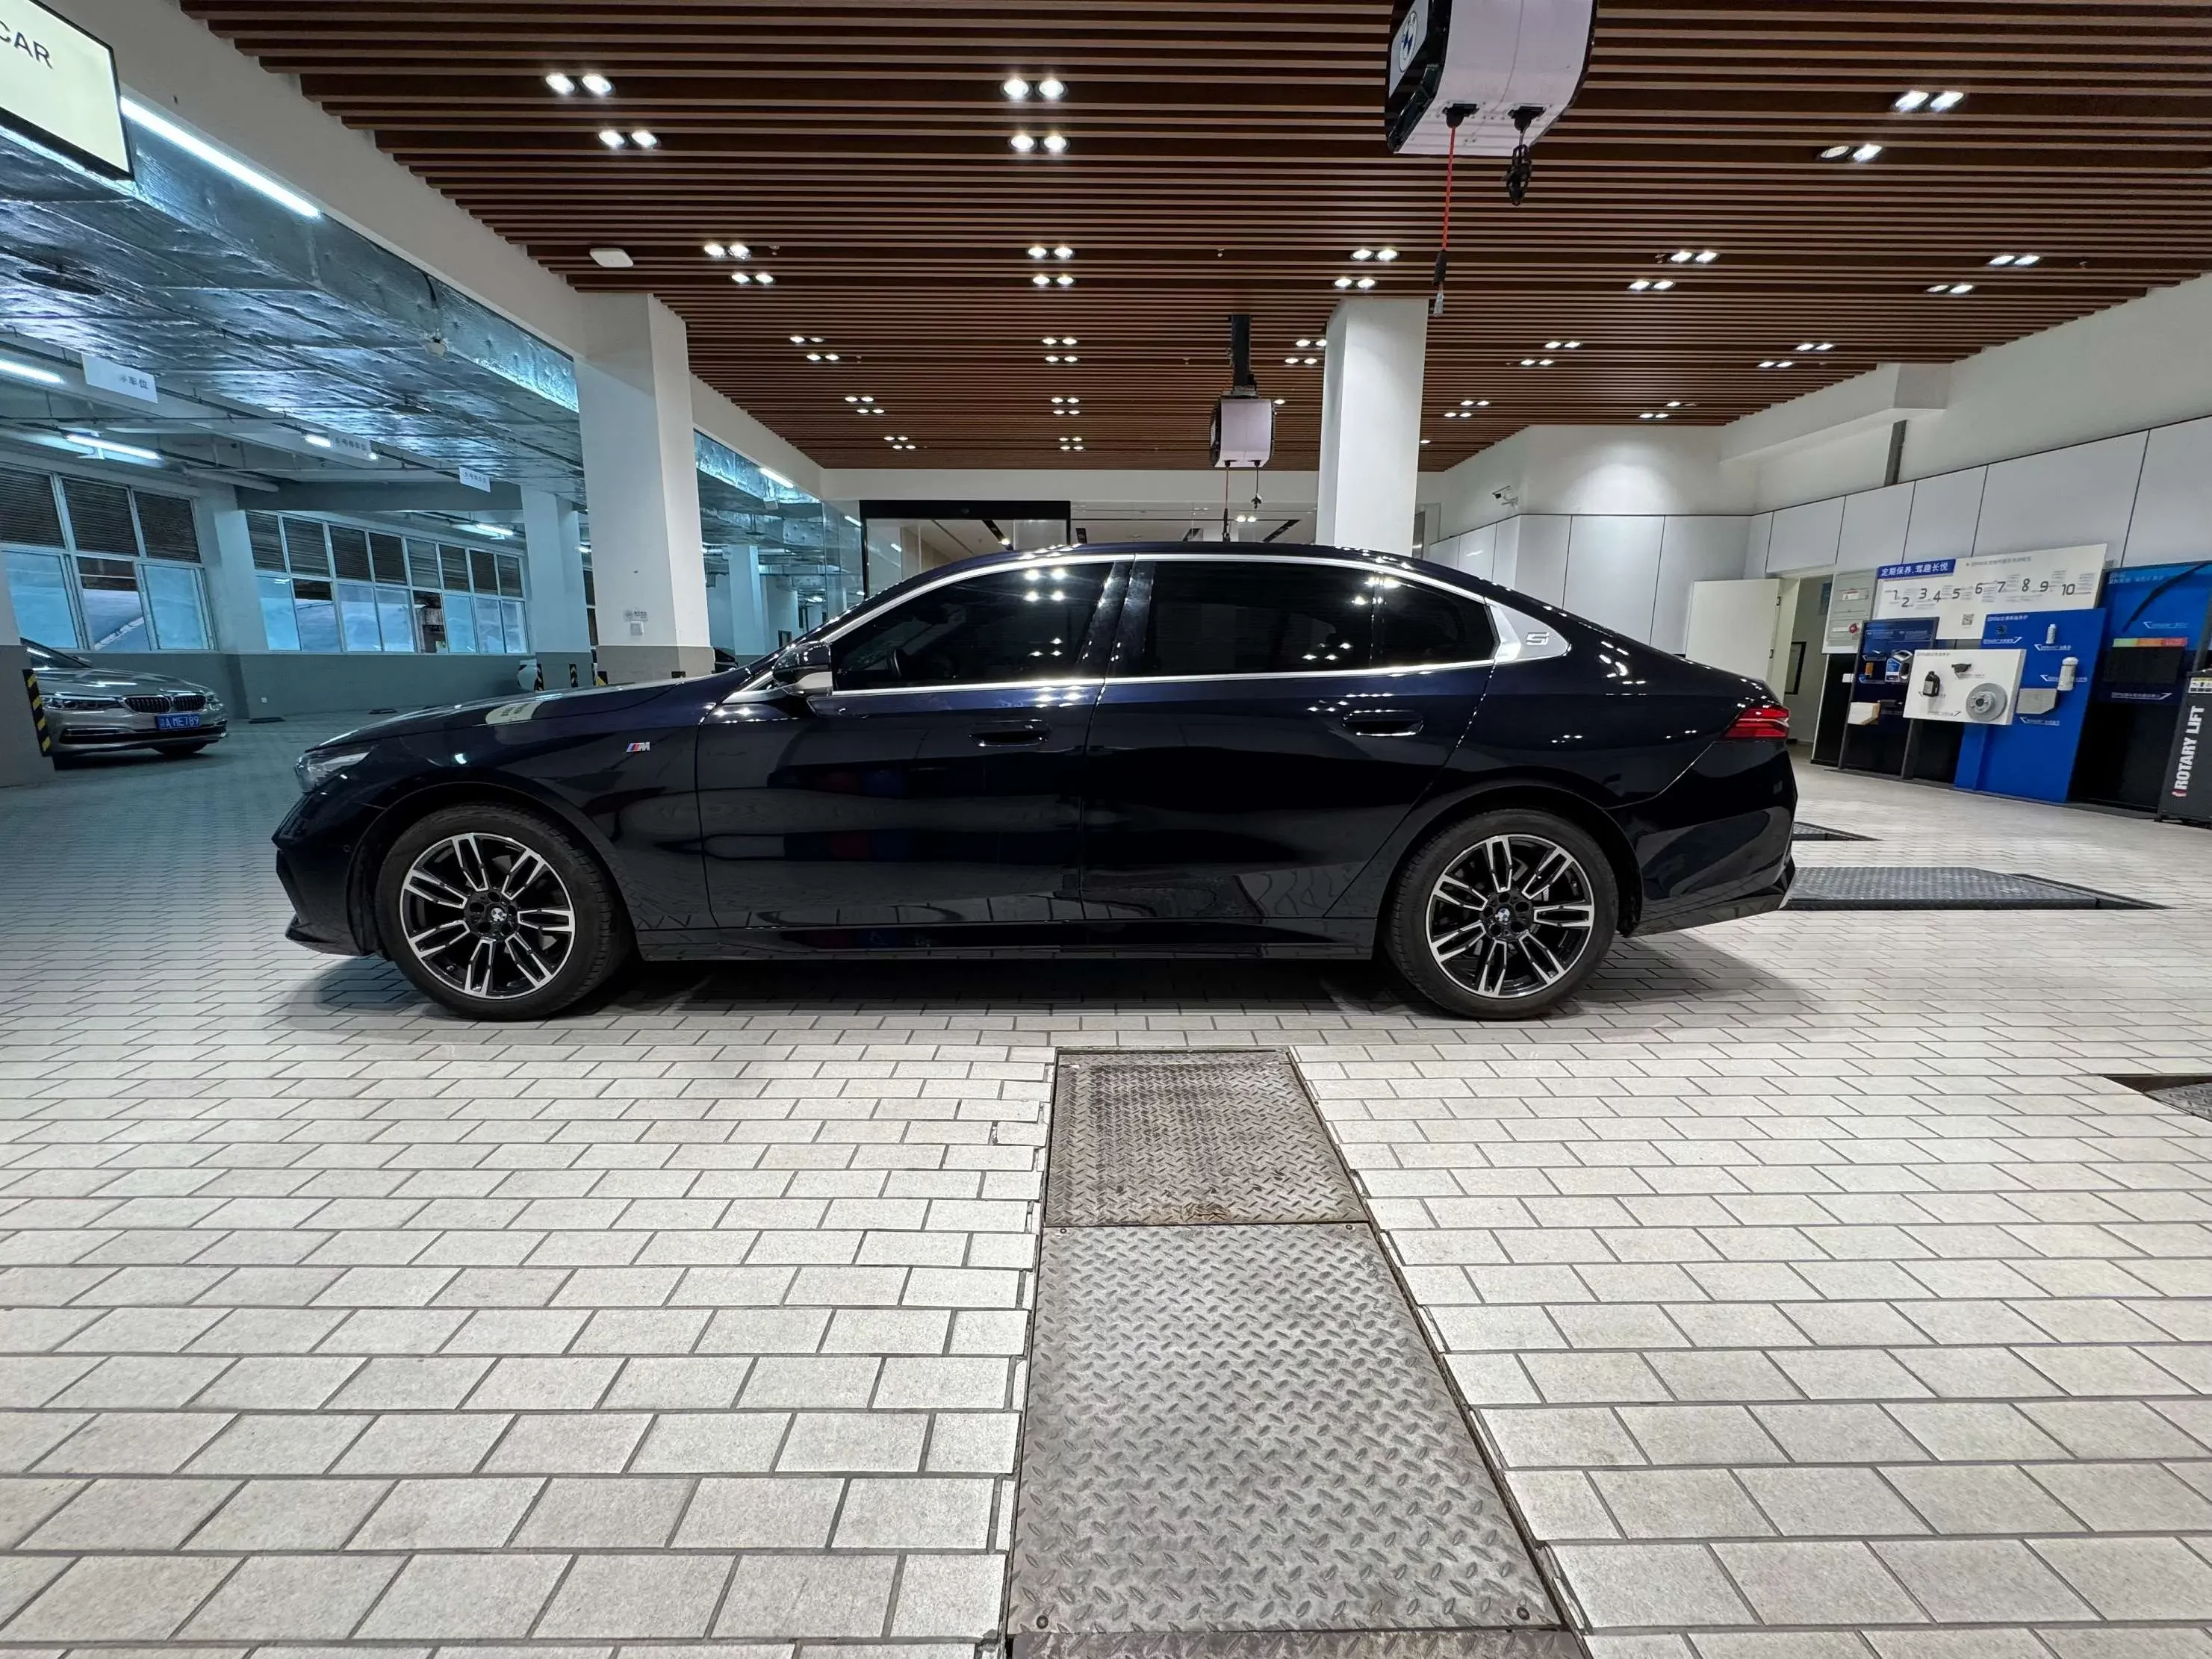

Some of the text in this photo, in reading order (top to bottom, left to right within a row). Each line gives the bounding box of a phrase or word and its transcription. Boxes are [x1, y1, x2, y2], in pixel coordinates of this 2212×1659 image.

[1901, 597, 1910, 607] 2
[1919, 588, 1927, 600] 3
[1933, 591, 1941, 603] 4
[1951, 588, 1960, 600] 5
[1975, 582, 1983, 594] 6
[1997, 581, 2006, 593] 7
[2022, 578, 2031, 592] 8
[2039, 581, 2049, 593] 9
[2061, 583, 2076, 596] 10
[2185, 706, 2205, 735] LIFT
[2174, 736, 2198, 791] ROTARY
